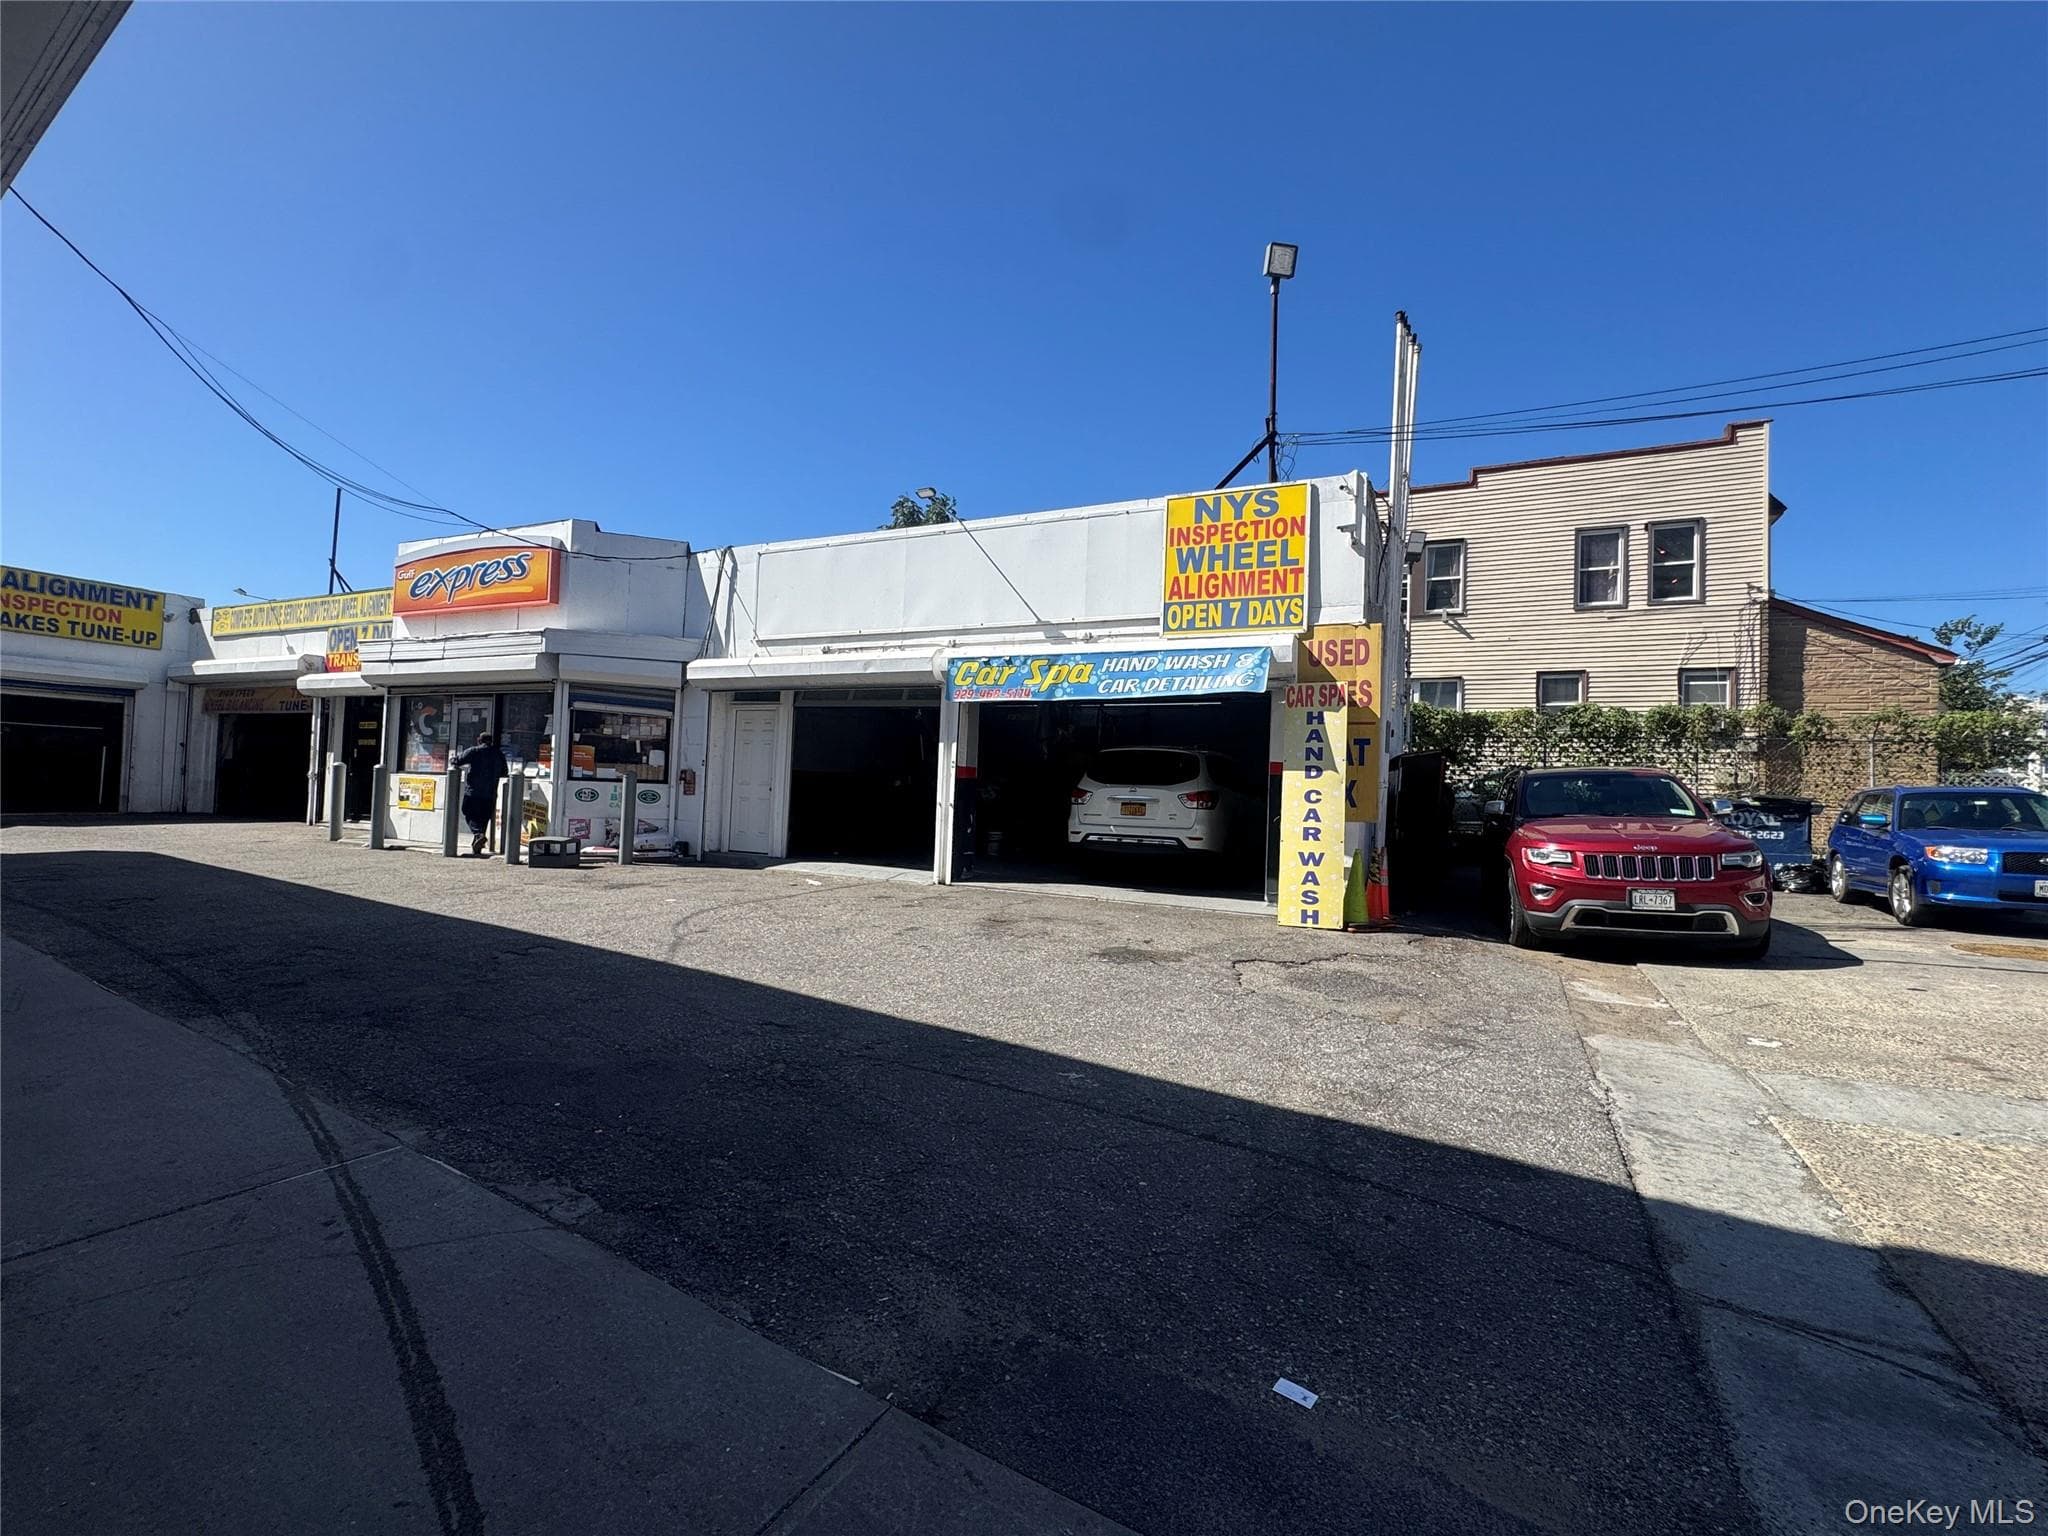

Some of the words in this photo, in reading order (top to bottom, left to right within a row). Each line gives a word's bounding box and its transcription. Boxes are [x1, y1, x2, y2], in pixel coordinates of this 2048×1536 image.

[1194, 490, 1280, 525] NYS
[1169, 515, 1306, 547] INSPECTION
[1176, 539, 1300, 575] WHEEL
[1, 570, 159, 611] ALIGNMENT
[409, 551, 533, 605] express
[1168, 567, 1305, 600] ALIGNMENT
[1167, 602, 1222, 630] OPEN
[1229, 601, 1242, 627] 7
[1248, 598, 1303, 626] DAYS
[67, 620, 158, 646] TUNE-UP
[329, 627, 357, 653] OPEN
[1100, 655, 1160, 674] HAND
[1164, 653, 1231, 673] WASH
[1235, 652, 1256, 669] &
[1307, 638, 1370, 667] USED
[954, 661, 1018, 687] Car
[1023, 659, 1095, 693] Spa
[1097, 678, 1140, 694] CAR
[1143, 671, 1256, 693] DETAILING
[1286, 685, 1315, 709] CAR
[1304, 711, 1325, 780] HAND
[1302, 789, 1322, 841] CAR
[1297, 851, 1325, 925] WASH
